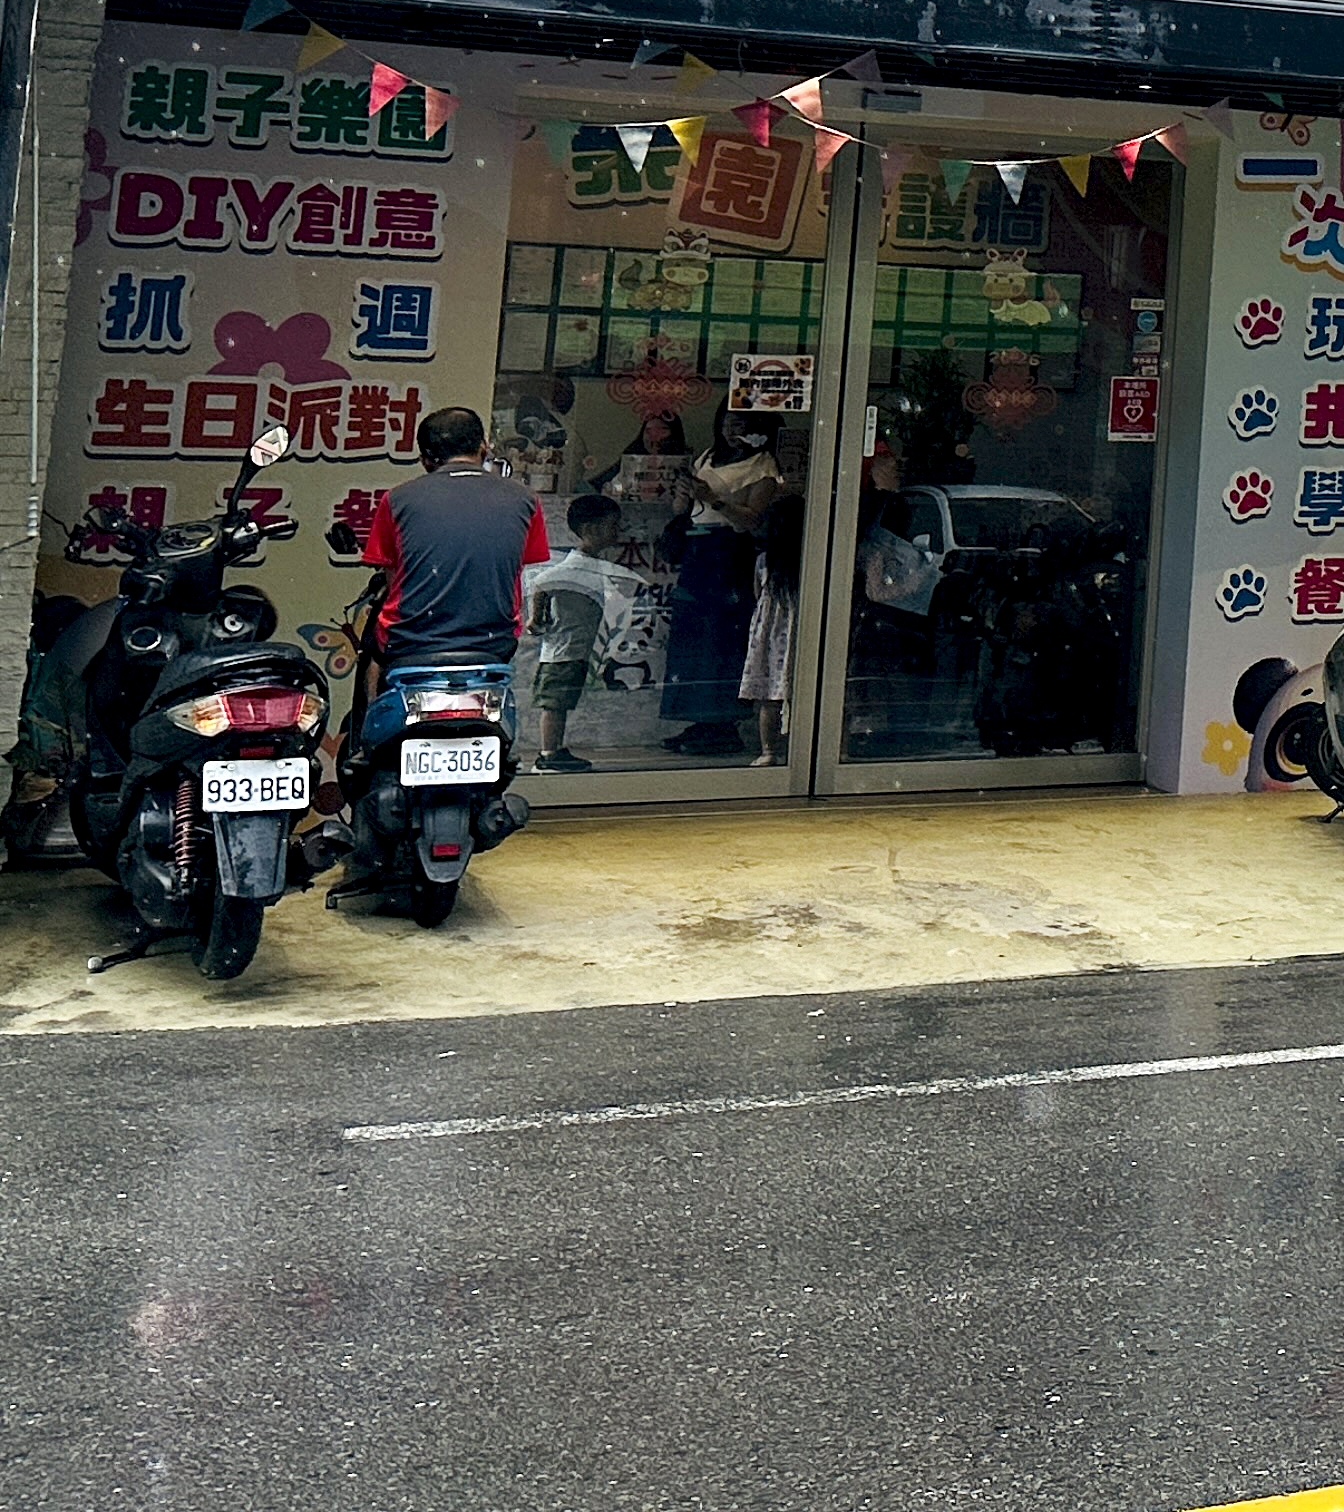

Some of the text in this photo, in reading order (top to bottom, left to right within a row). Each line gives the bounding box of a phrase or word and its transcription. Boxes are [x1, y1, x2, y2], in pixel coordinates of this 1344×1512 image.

[128, 67, 450, 152] 親子樂園
[115, 173, 439, 250] DIY創意
[106, 273, 432, 350] 抓週
[91, 379, 422, 453] 生日派對
[207, 775, 306, 804] 933-BEQ
[404, 749, 496, 775] NGC-3036
